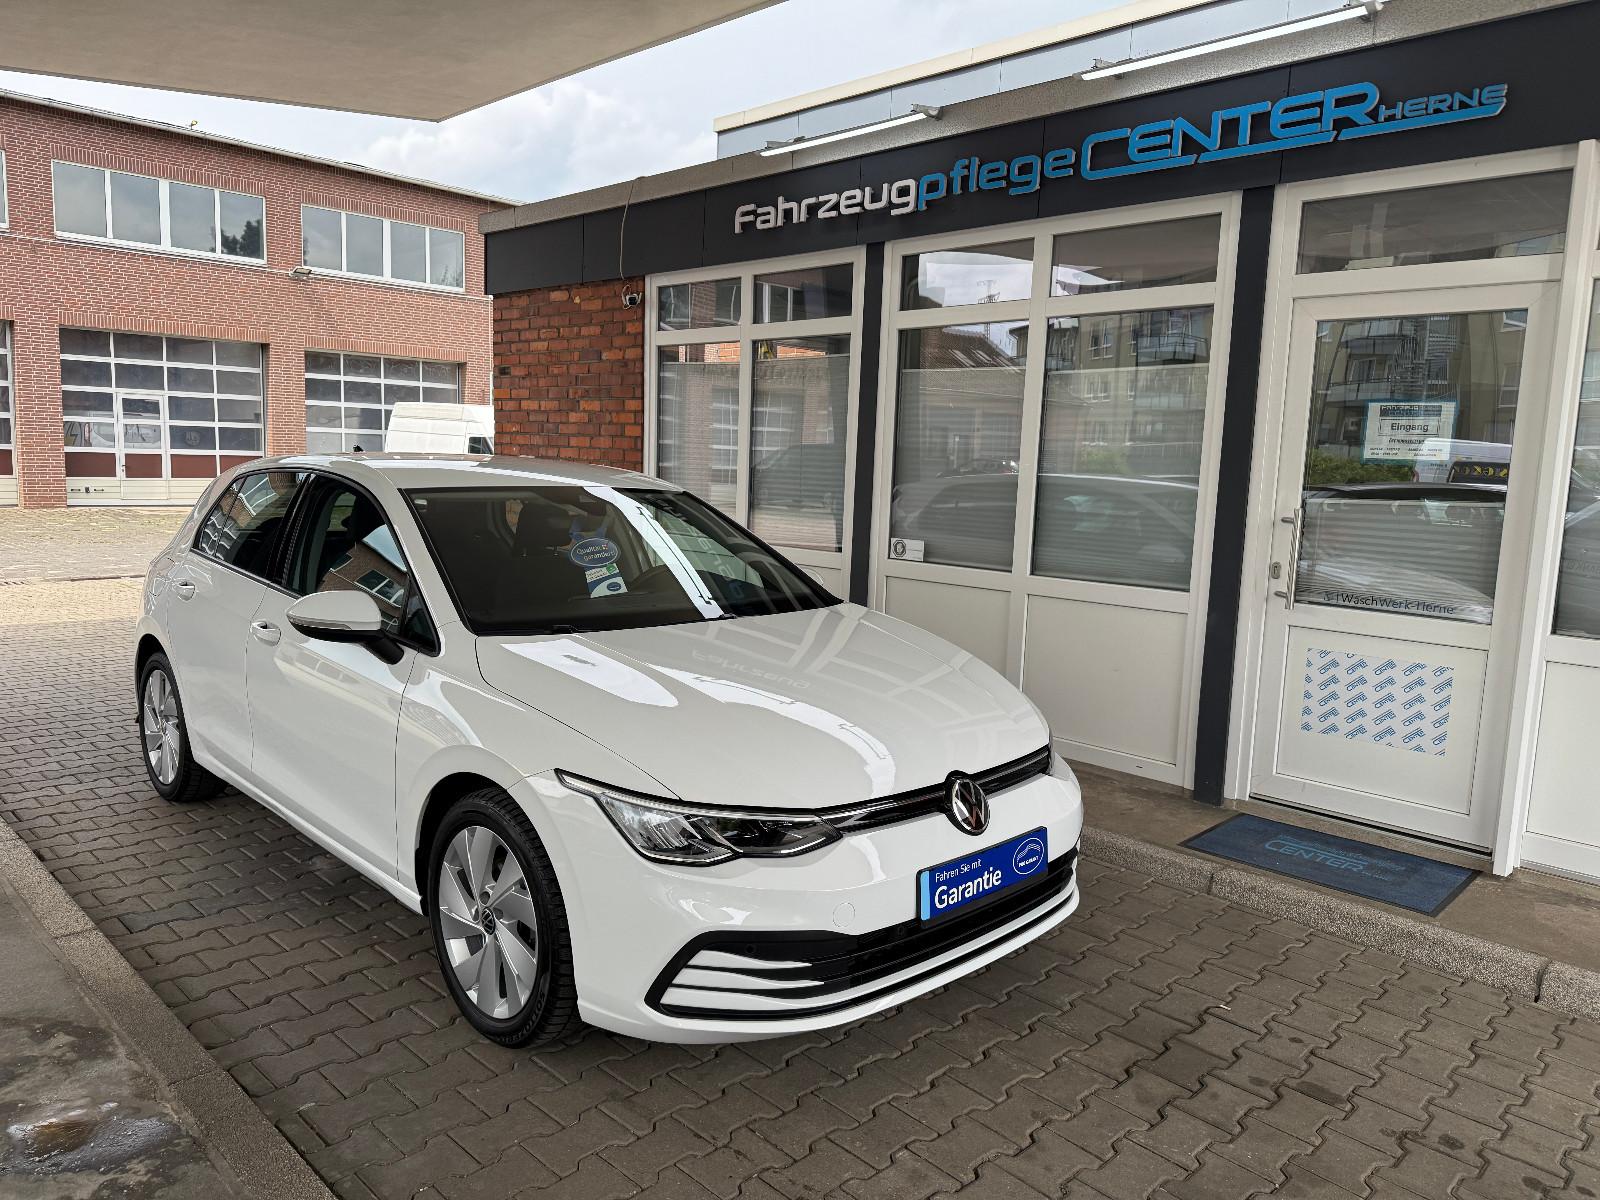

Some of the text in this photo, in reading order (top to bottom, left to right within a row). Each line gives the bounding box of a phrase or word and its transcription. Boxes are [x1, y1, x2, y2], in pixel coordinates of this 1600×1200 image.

[1377, 83, 1508, 122] HERNE
[1390, 422, 1430, 433] Eingang
[935, 858, 982, 883] Fahren Sie mit
[1264, 839, 1368, 873] CENTER
[934, 866, 1002, 909] Garantie
